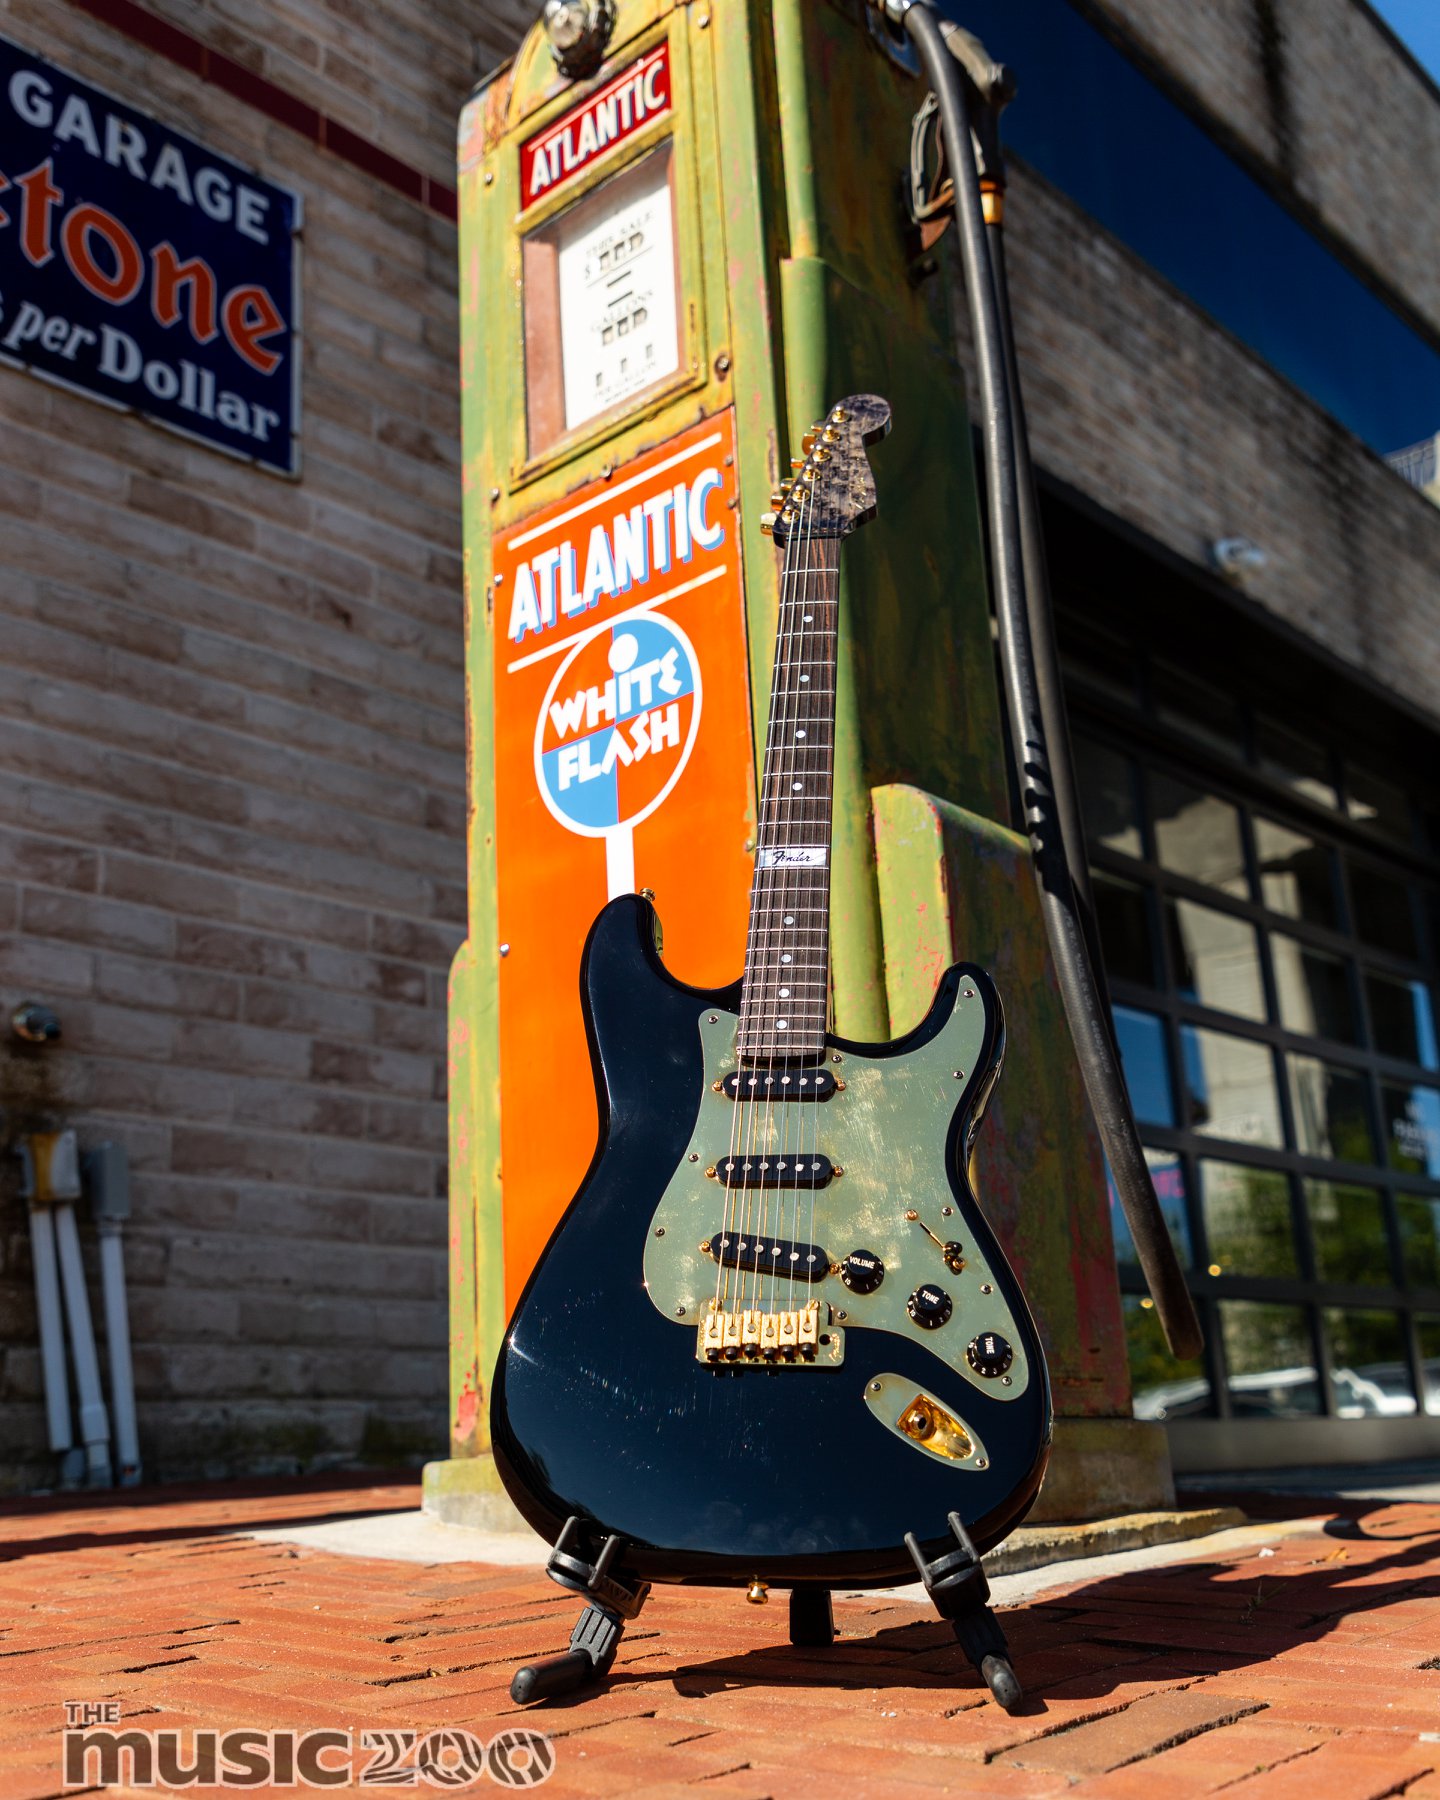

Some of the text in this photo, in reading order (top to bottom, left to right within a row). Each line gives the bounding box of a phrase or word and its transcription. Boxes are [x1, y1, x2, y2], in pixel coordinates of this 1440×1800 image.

[8, 70, 271, 245] GARAGE
[529, 59, 666, 197] ATLANTIC
[4, 301, 280, 442] per Dollar
[507, 467, 725, 643] ATLANTIC
[548, 633, 683, 739] WHITE
[558, 702, 681, 792] FLASH
[772, 850, 814, 866] Fender
[849, 1255, 876, 1270] VOLUME
[921, 1290, 940, 1305] TONE
[984, 1336, 995, 1355] TONE
